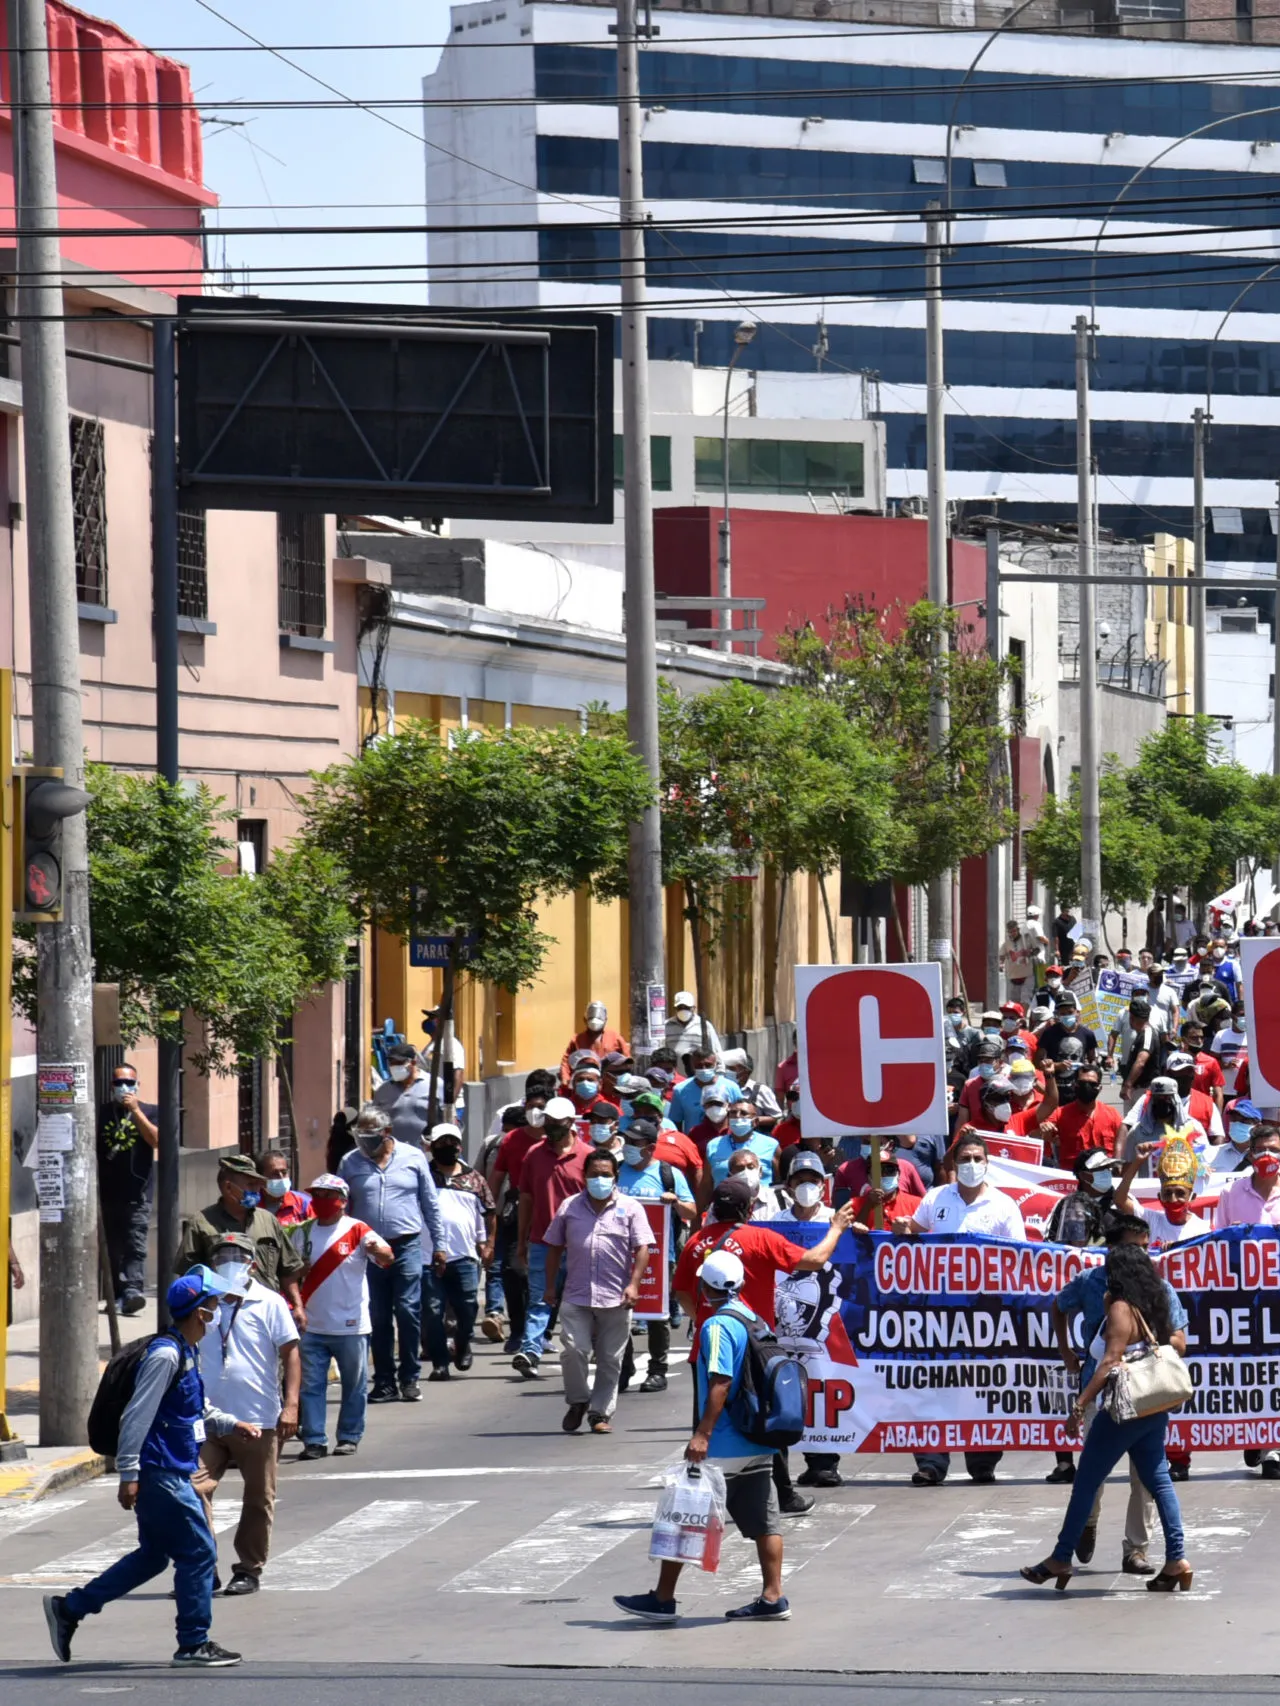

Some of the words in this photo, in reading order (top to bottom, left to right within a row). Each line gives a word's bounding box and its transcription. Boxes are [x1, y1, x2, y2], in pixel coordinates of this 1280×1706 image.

[806, 969, 935, 1128] C
[937, 1207, 948, 1221] 4
[858, 1309, 1018, 1349] JORNADA
[1210, 1307, 1251, 1345] DE
[1209, 1362, 1235, 1387] EN
[945, 1422, 966, 1447] EL
[970, 1420, 1014, 1446] ALZA
[1020, 1420, 1050, 1446] DEL
